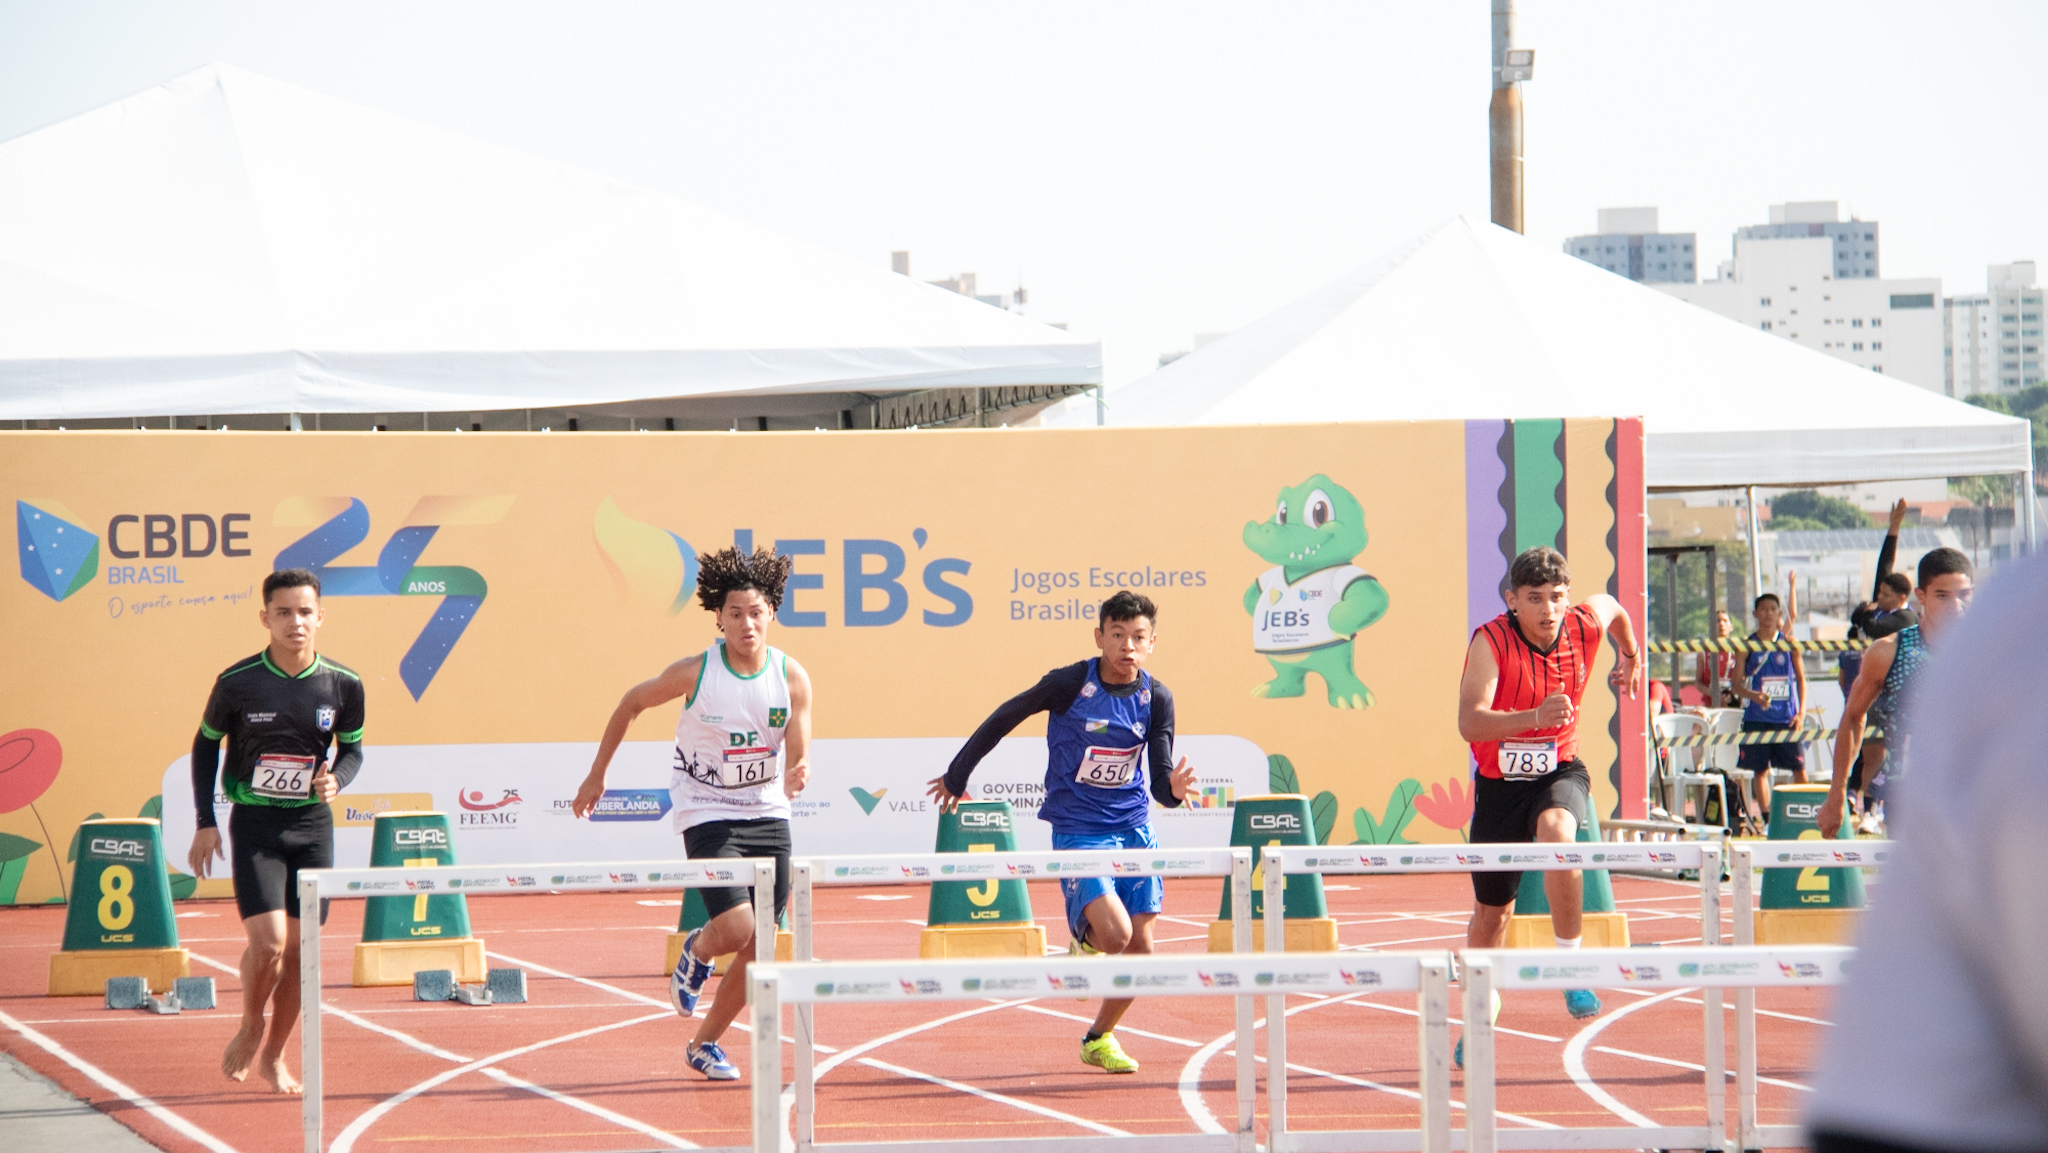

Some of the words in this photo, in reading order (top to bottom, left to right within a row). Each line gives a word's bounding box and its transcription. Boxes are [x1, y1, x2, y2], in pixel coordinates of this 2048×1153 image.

[108, 513, 251, 559] CBDE
[108, 565, 184, 585] BRASIL
[1010, 568, 1080, 594] Jogos
[1089, 566, 1207, 588] Escolares
[408, 581, 446, 593] ANOS
[108, 596, 123, 619] O
[131, 594, 173, 615] esporte
[223, 585, 253, 605] aqui!
[1010, 599, 1101, 621] Brasilei
[1261, 608, 1310, 631] JEB's
[1766, 684, 1787, 697] 647
[730, 731, 758, 747] DF
[736, 760, 765, 783] 161
[1506, 752, 1548, 774] 783
[261, 769, 302, 791] 266
[1090, 763, 1130, 782] 650
[503, 789, 519, 800] 25
[983, 783, 1044, 794] GOVERN
[889, 801, 927, 812] VALE
[1008, 798, 1044, 808] MINA
[460, 813, 517, 825] FEEMG
[97, 864, 135, 930] 8
[403, 857, 438, 922] 7
[1801, 894, 1830, 903] UCS
[970, 910, 1001, 919] UCS
[101, 934, 134, 943] UCS
[410, 926, 442, 936] UCS
